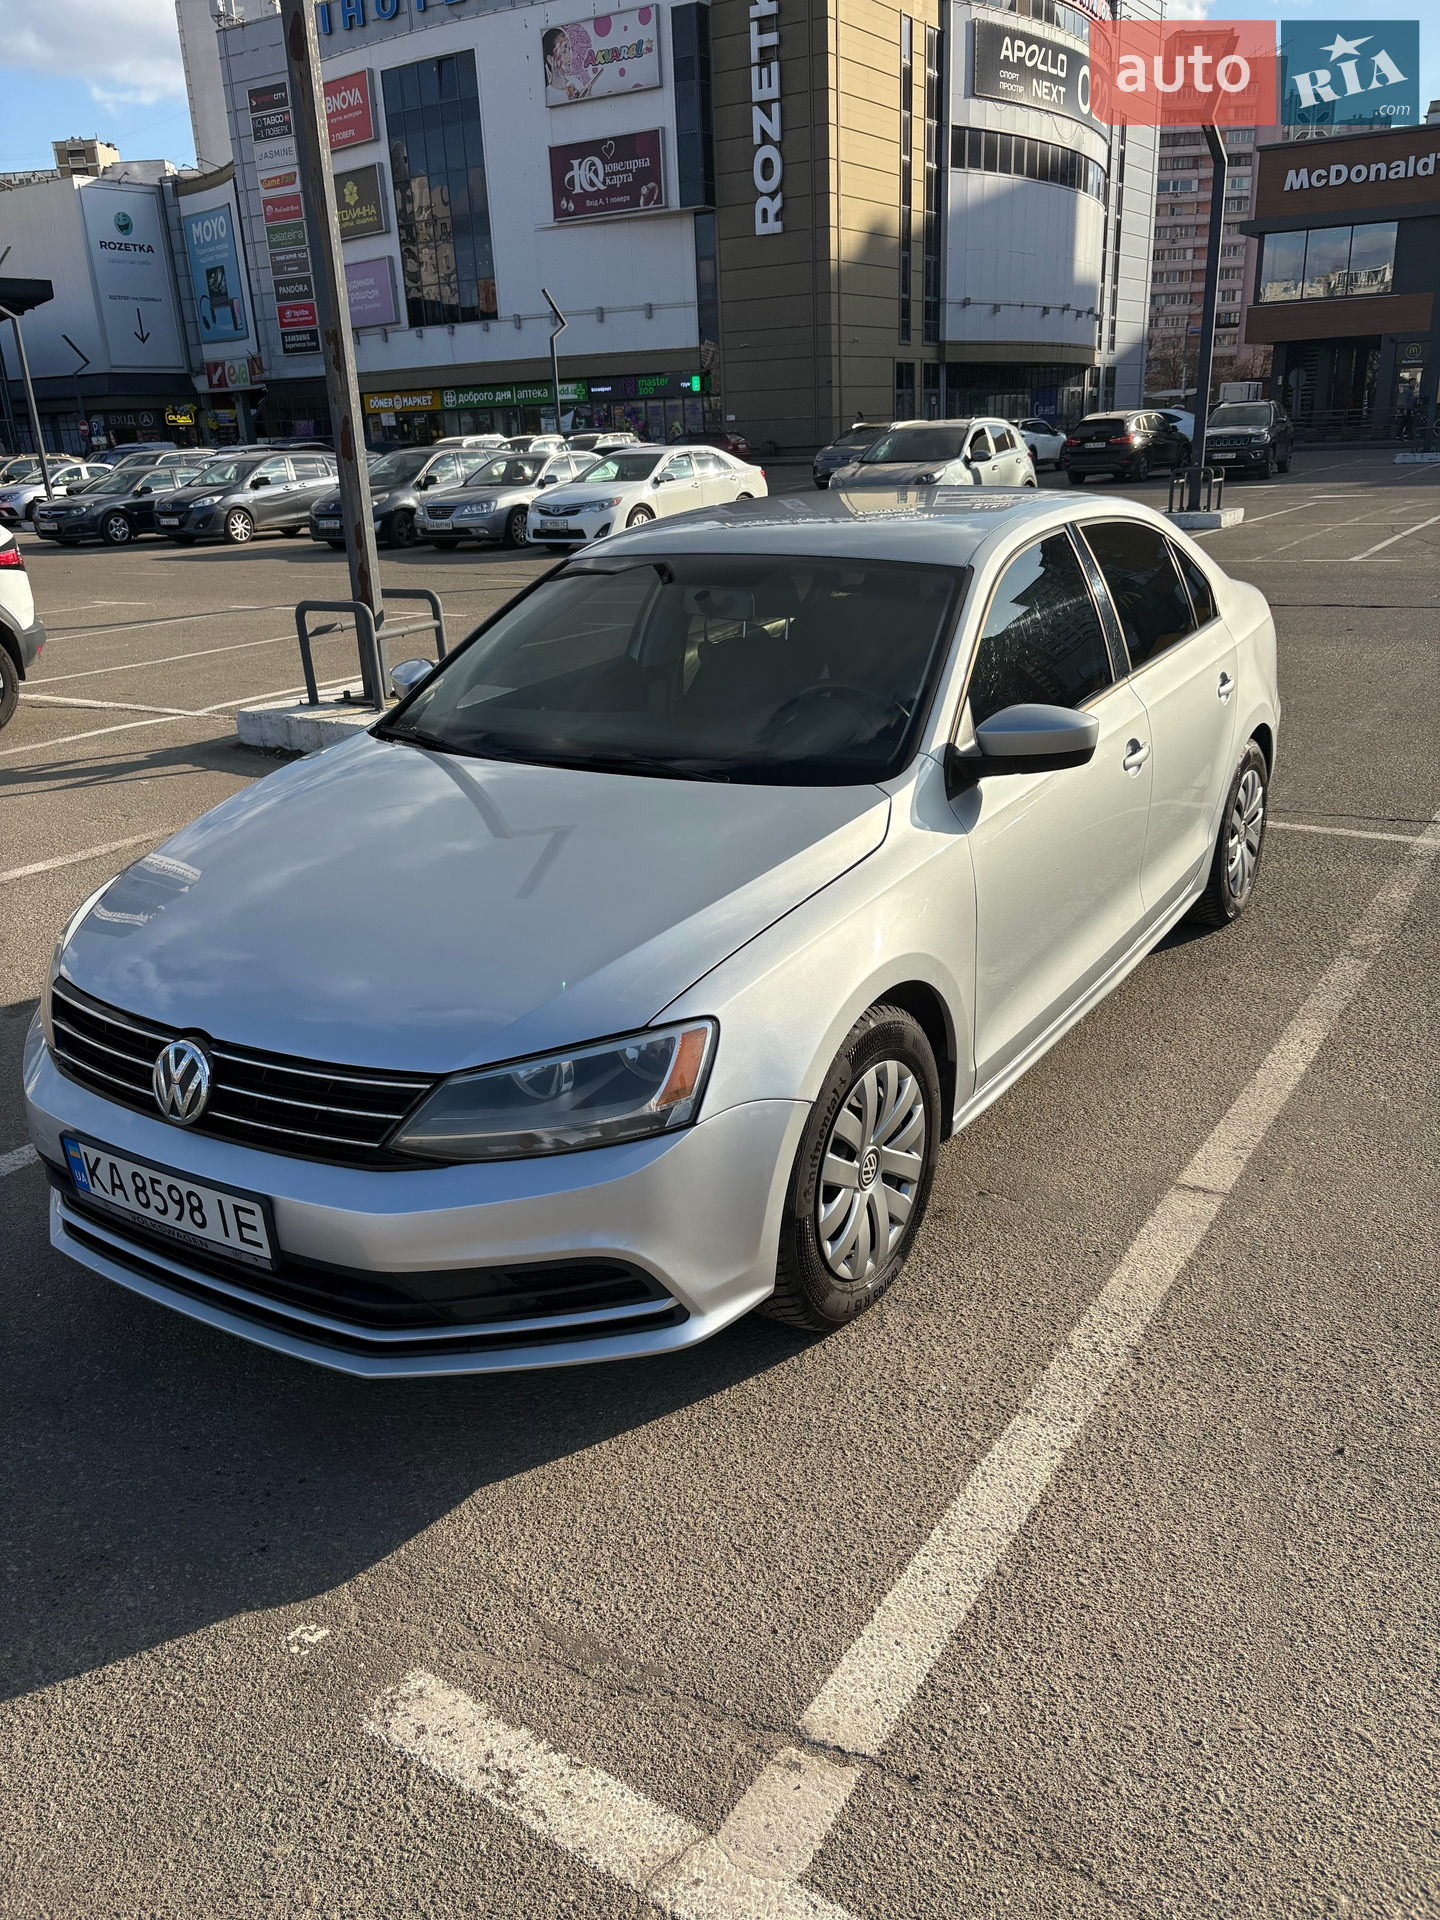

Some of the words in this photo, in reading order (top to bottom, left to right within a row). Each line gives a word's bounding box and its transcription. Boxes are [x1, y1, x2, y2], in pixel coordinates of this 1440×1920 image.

[1000, 36, 1068, 78] APOLLO
[999, 70, 1020, 82] СПОРТ
[1032, 78, 1066, 105] NEXT
[263, 114, 284, 126] TABOO
[265, 125, 289, 136] ПОВЕРХ
[259, 147, 293, 160] JASMINE
[604, 157, 650, 173] ювелірна
[263, 178, 281, 188] Game
[281, 173, 296, 183] Park
[605, 173, 633, 187] карта
[610, 195, 631, 205] поверх
[192, 215, 227, 245] MOYO
[269, 229, 303, 243] salateira
[99, 240, 155, 254] ROZETKA
[285, 334, 310, 342] SAMSUNG
[285, 342, 306, 350] Experience
[638, 377, 669, 387] master
[458, 391, 493, 405] доброго
[495, 390, 511, 402] дня
[517, 388, 548, 399] аптека
[638, 387, 655, 395] zoo
[370, 397, 393, 409] DÖNER
[109, 414, 136, 426] ВХІД
[92, 422, 98, 434] P
[803, 1088, 841, 1205] Continental
[75, 1170, 88, 1185] UA
[83, 1151, 130, 1203] KA
[131, 1171, 207, 1229] 8598
[217, 1199, 264, 1250] IE
[129, 1213, 209, 1249] VOLKSWAGEN
